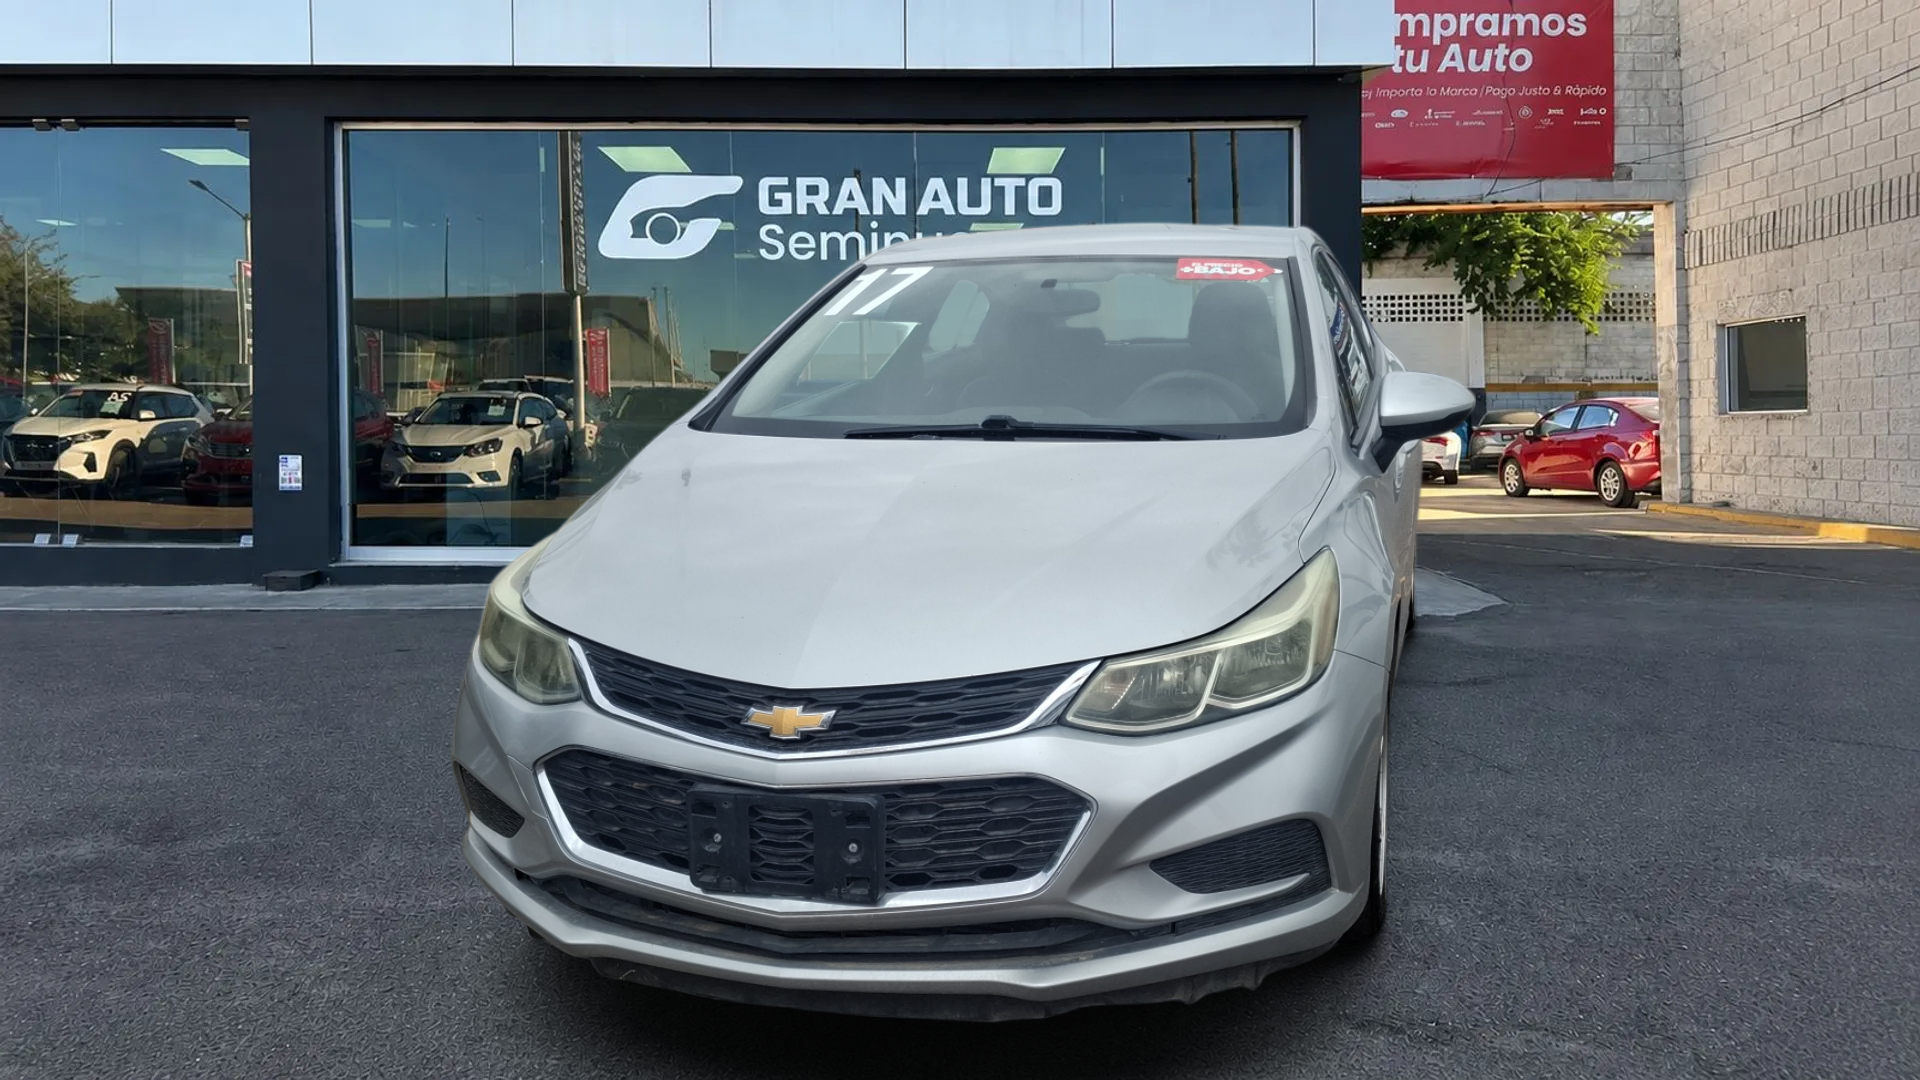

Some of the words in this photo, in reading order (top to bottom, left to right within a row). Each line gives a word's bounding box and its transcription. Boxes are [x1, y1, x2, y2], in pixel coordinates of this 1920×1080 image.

[1392, 45, 1430, 73] tu
[1437, 43, 1533, 73] Auto
[1376, 87, 1423, 99] Importa
[1426, 86, 1437, 96] la
[1440, 86, 1478, 96] Marca
[1518, 86, 1550, 96] Justo
[1553, 86, 1561, 96] &
[758, 176, 906, 216] GRAN
[917, 177, 1062, 216] AUTO
[824, 266, 935, 316] 17
